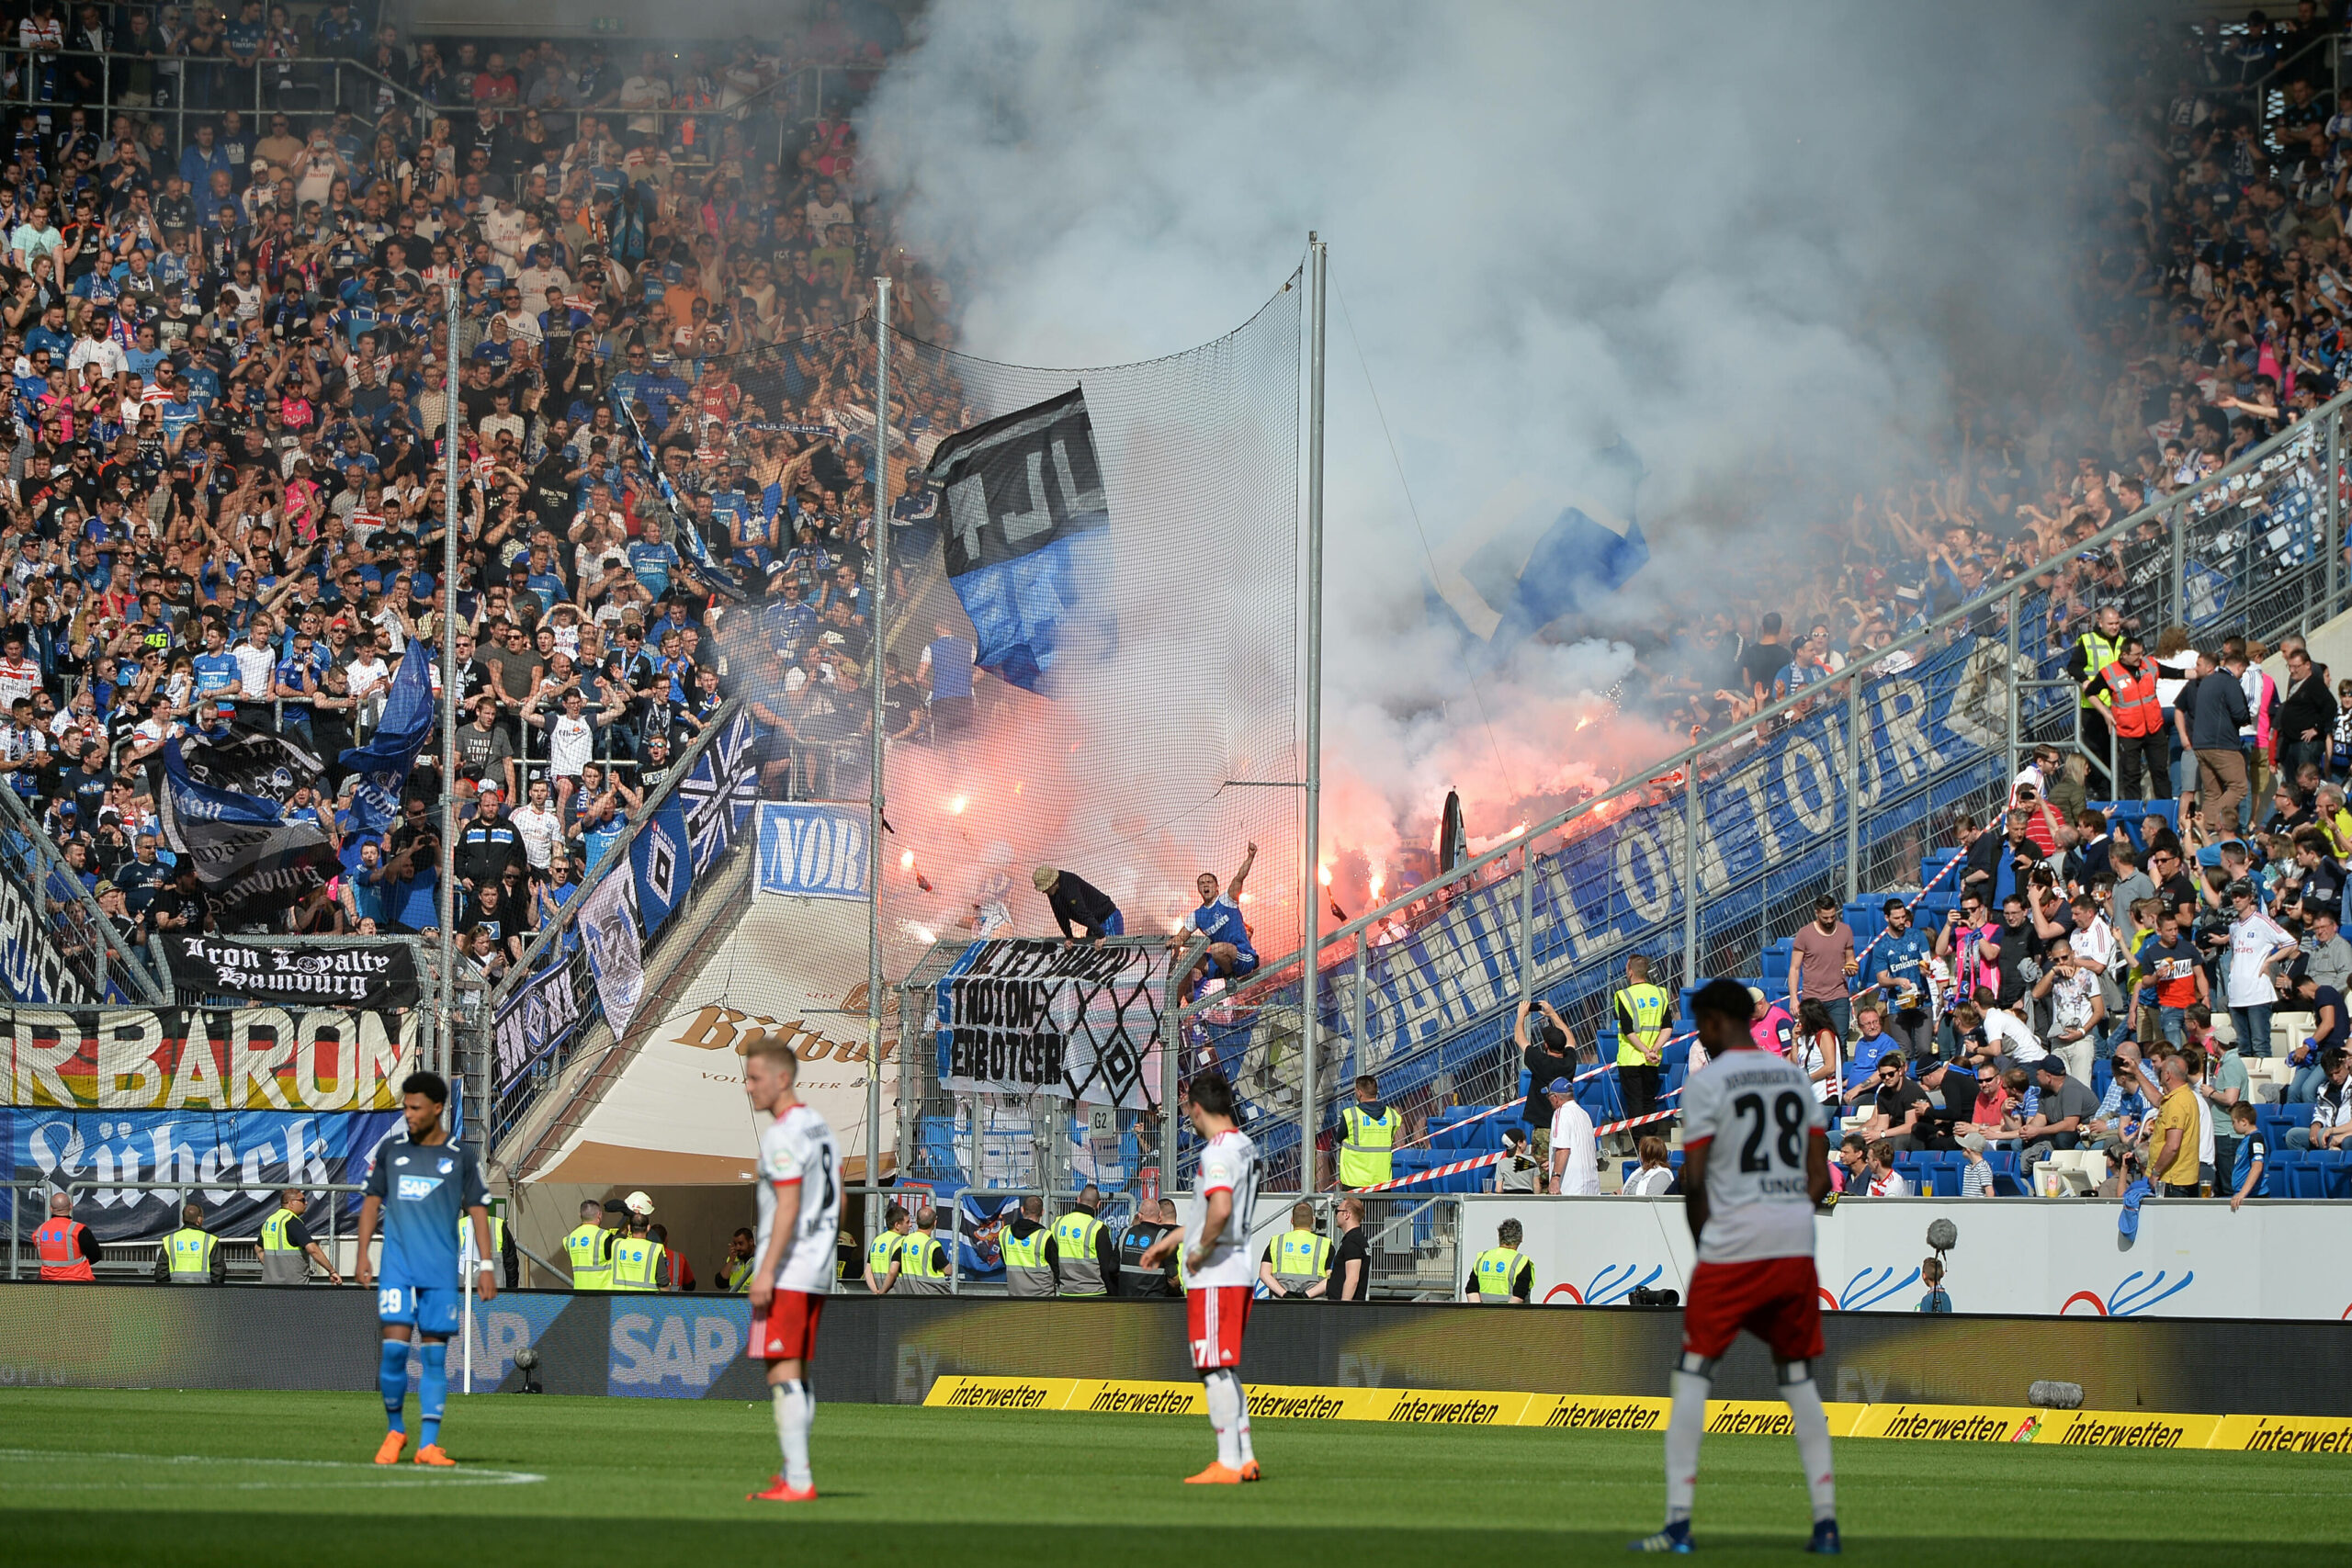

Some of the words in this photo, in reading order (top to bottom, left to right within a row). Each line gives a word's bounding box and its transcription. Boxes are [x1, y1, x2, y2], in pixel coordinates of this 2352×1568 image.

[144, 633, 167, 649] 46
[182, 937, 260, 969] Iron
[1889, 958, 1920, 973] Emirates
[96, 1008, 418, 1110] BÄRON
[1093, 1111, 1108, 1130] G2
[1734, 1089, 1804, 1174] 28
[28, 1118, 331, 1210] Lübeck
[399, 1179, 434, 1197] SAP
[378, 1288, 402, 1314] 29
[612, 1313, 739, 1385] SAP
[946, 1377, 1048, 1408] interwetten
[1089, 1382, 1194, 1415] interwetten
[1388, 1391, 1500, 1425] interwetten
[1544, 1395, 1660, 1430] interwetten
[1883, 1405, 2008, 1441] interwetten
[2061, 1412, 2184, 1449] interwetten
